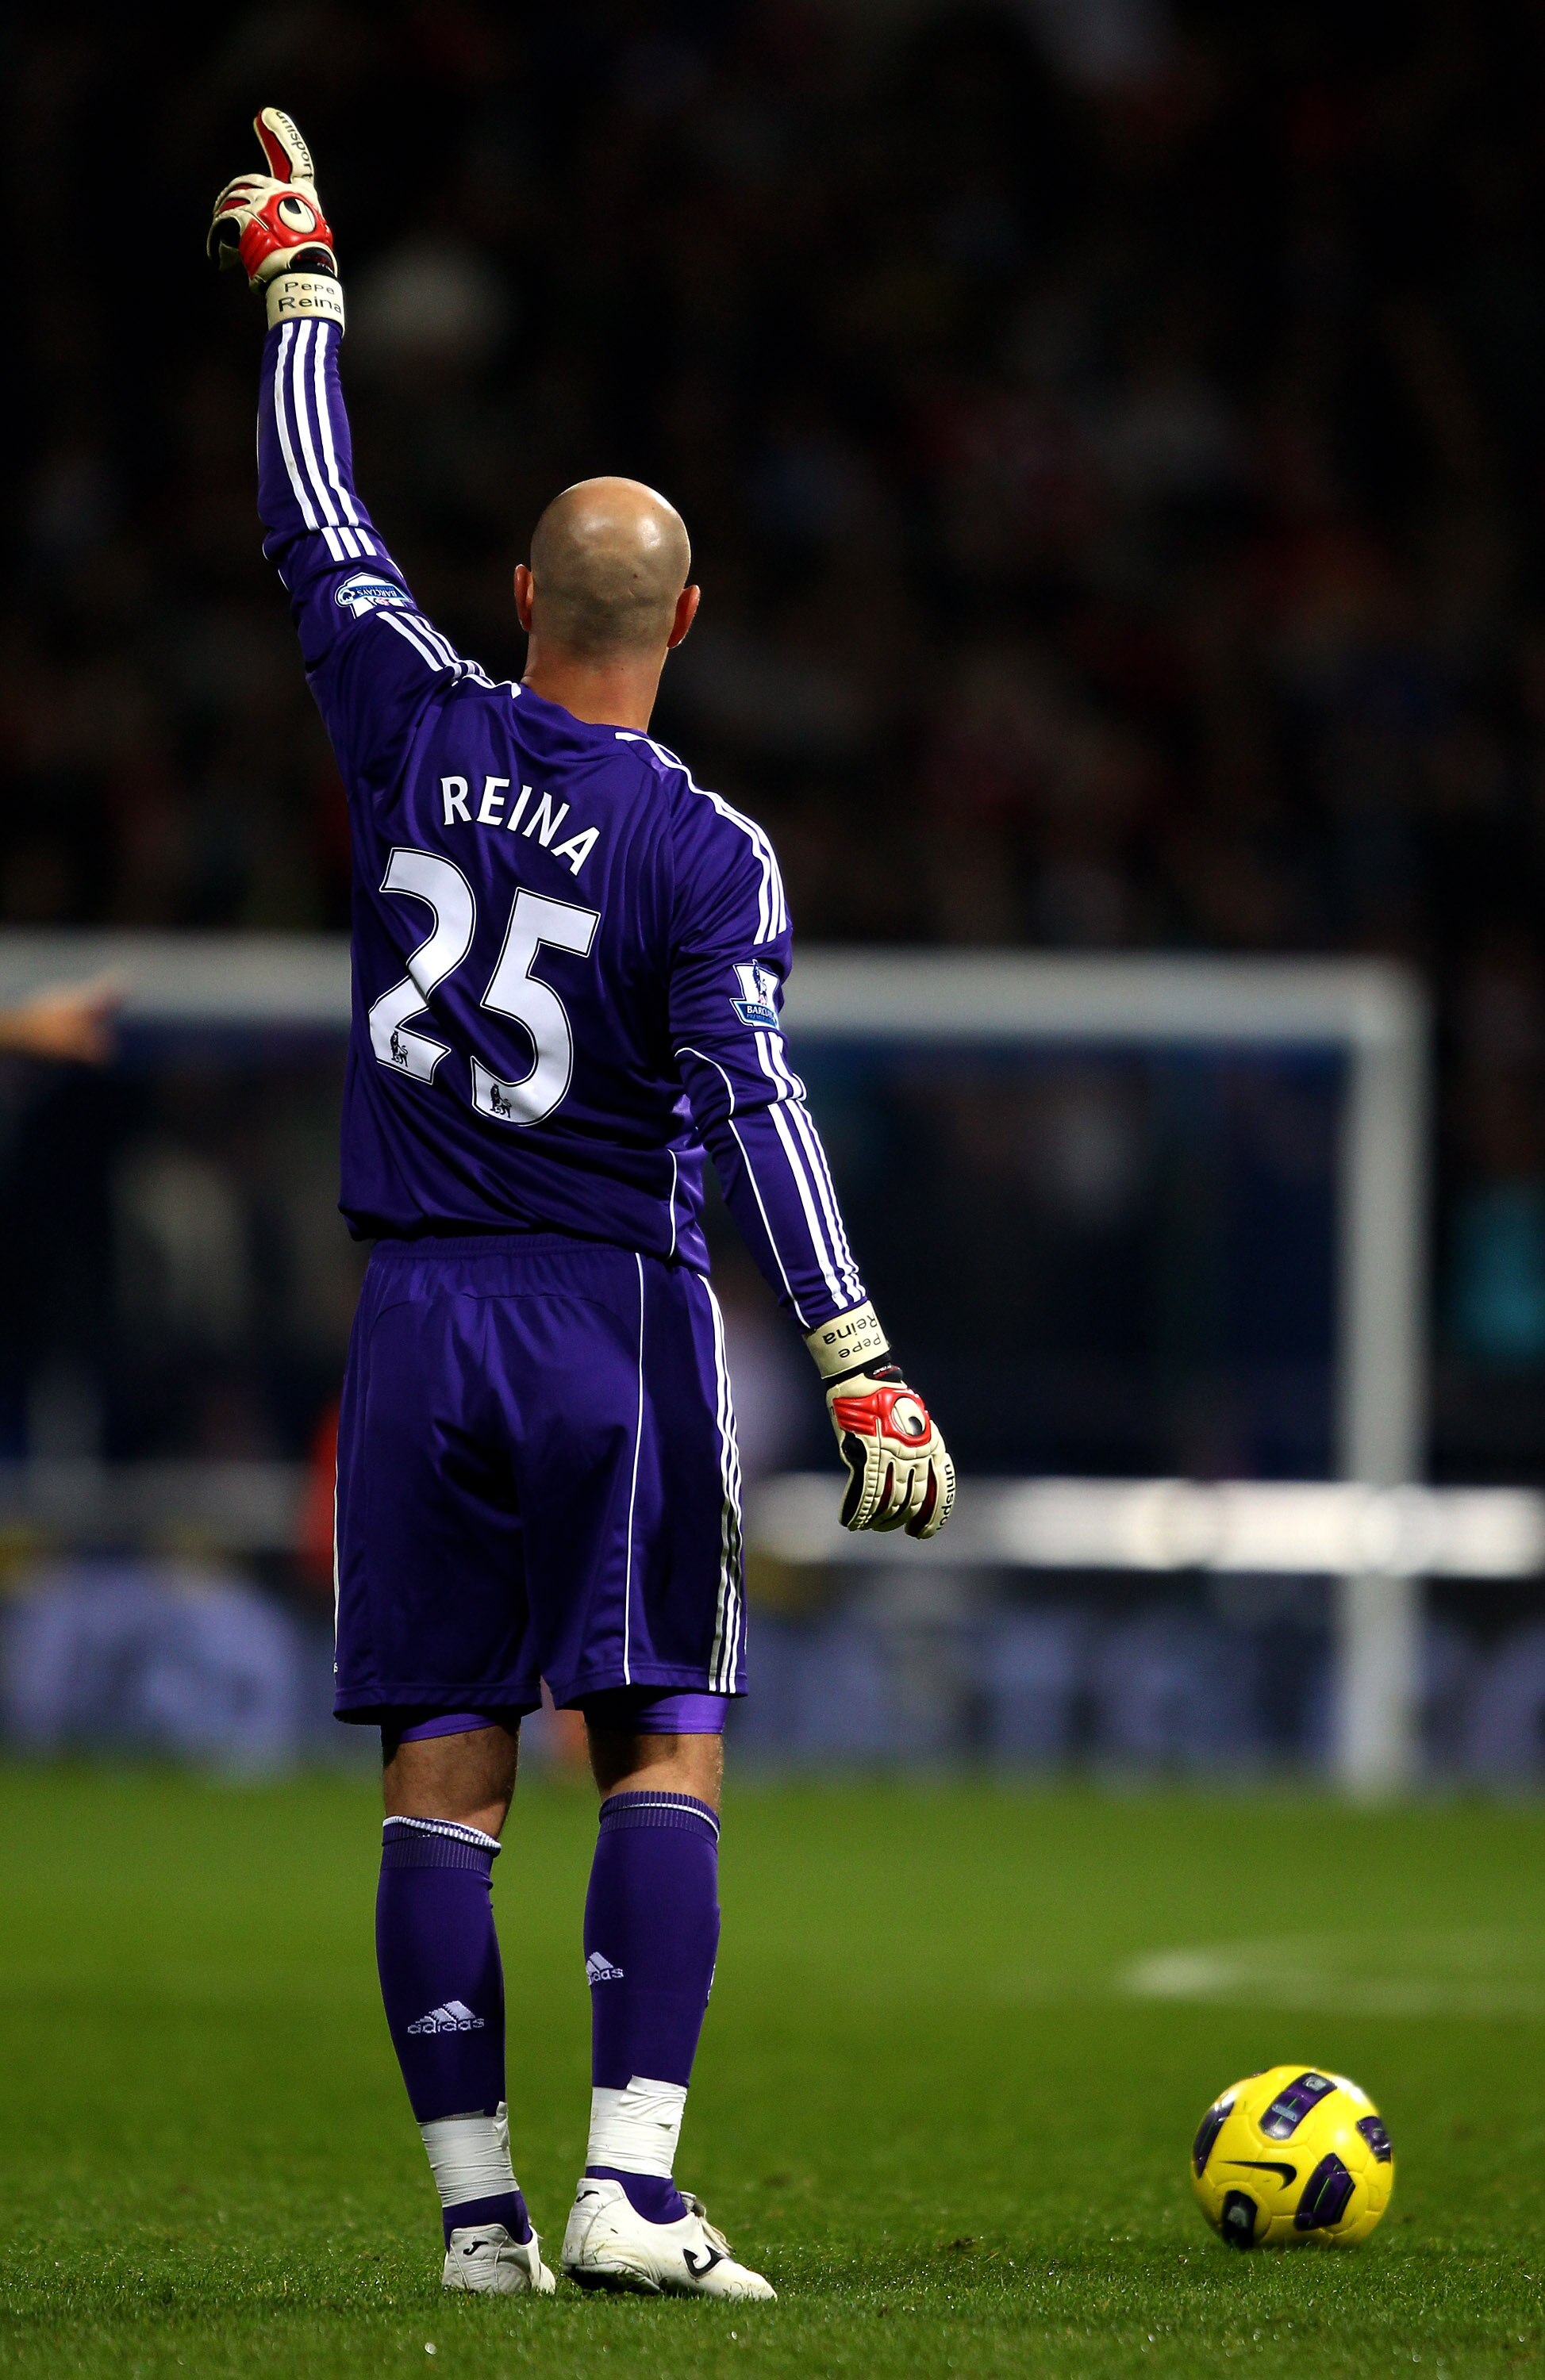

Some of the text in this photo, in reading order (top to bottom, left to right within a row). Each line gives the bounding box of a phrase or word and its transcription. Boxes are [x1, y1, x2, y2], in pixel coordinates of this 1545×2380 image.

[278, 296, 341, 314] Reina
[356, 589, 398, 597] BARCLAYS
[440, 775, 601, 876] REINA
[368, 846, 601, 1127] 25
[822, 1311, 878, 1345] Reina
[407, 2017, 485, 2034] adidas
